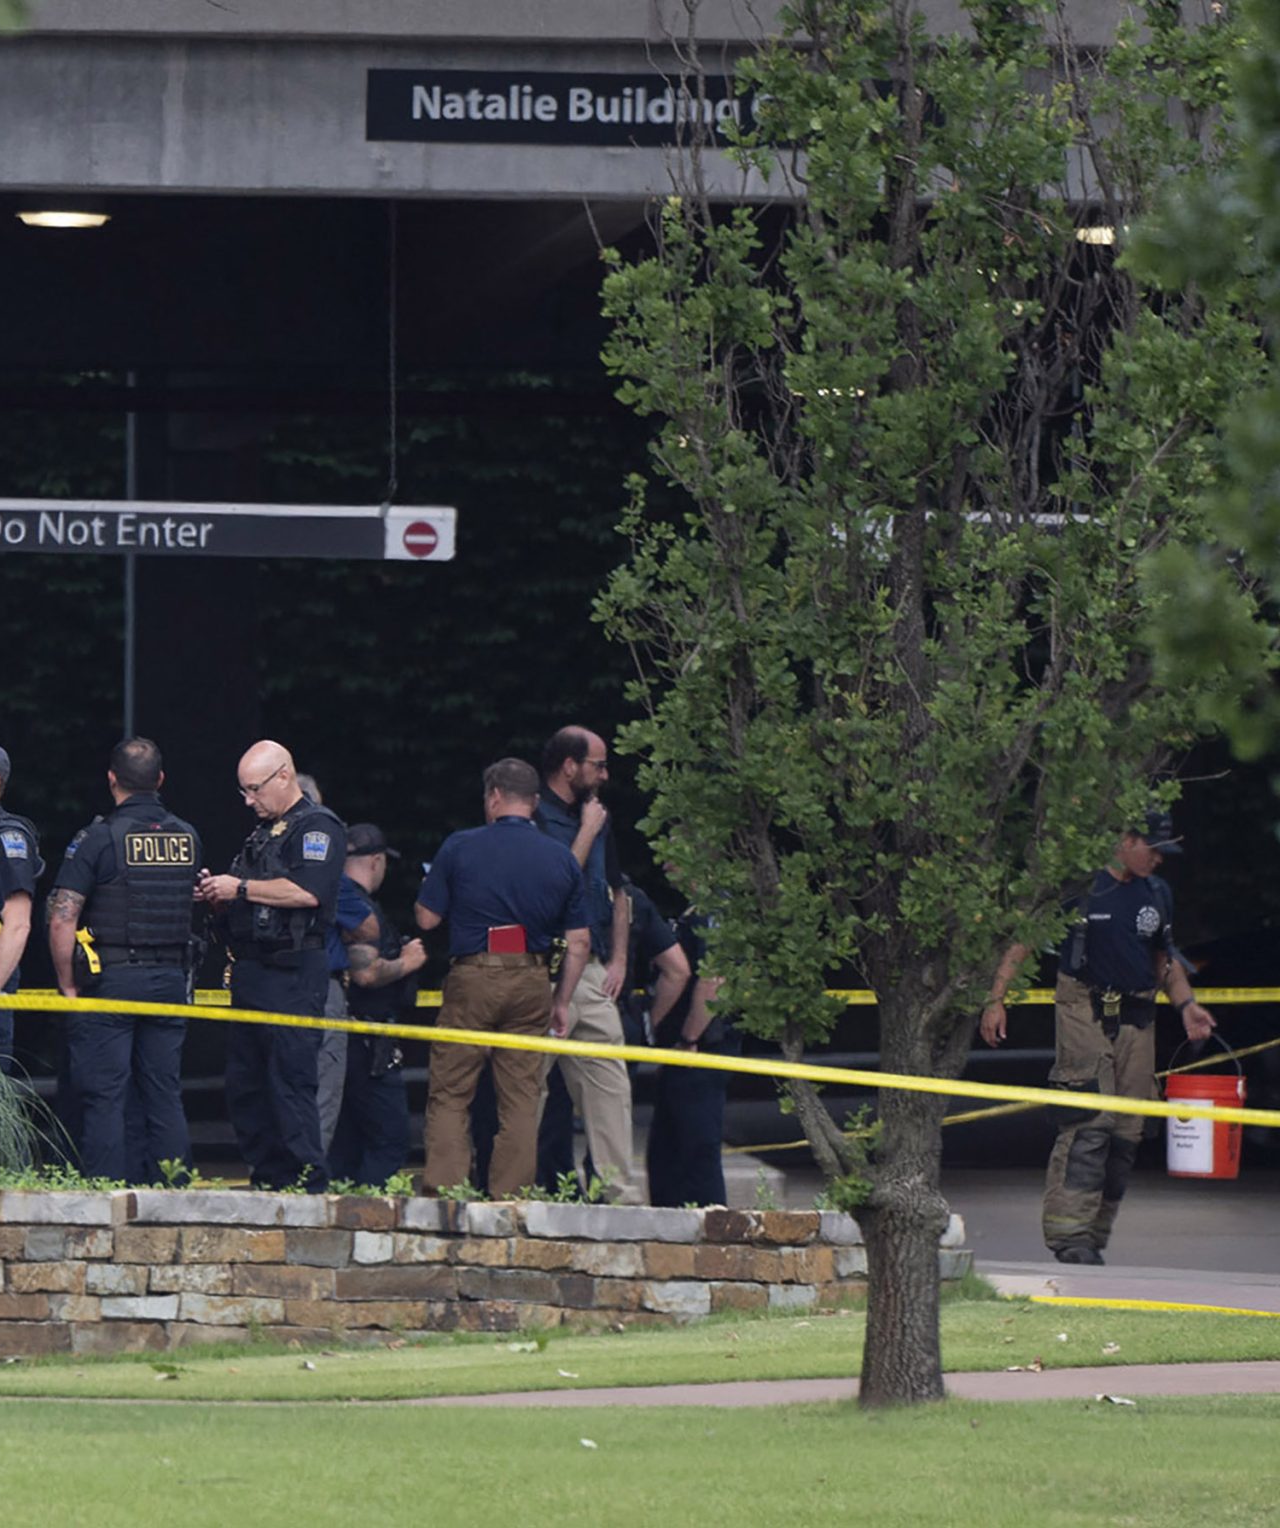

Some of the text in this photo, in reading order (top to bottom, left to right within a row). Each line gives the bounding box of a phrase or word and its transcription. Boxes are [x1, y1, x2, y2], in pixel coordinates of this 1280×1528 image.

[412, 85, 558, 121] Natalie
[38, 511, 106, 546] Not
[116, 513, 213, 548] Enter
[132, 837, 189, 861] POLICE
